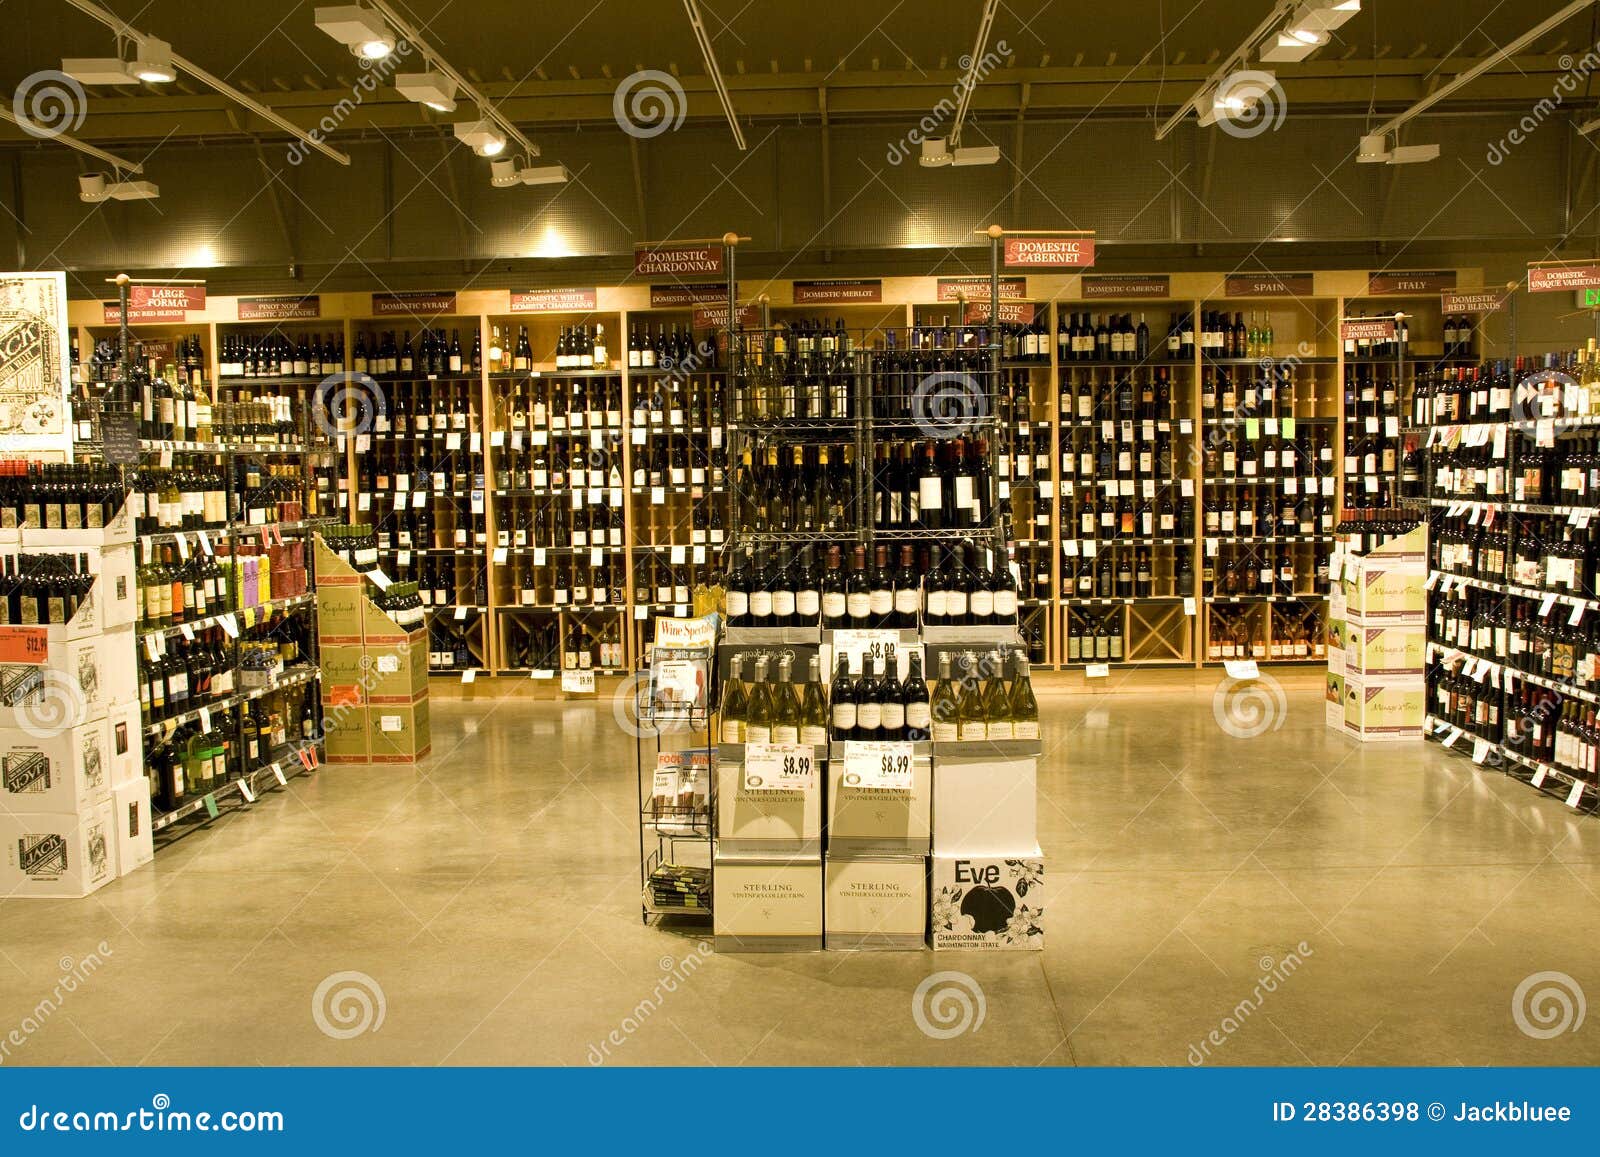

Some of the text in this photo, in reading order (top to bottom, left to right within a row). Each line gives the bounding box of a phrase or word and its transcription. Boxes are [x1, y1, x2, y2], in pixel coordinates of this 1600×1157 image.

[1018, 243, 1080, 252] DOMESTIC
[648, 251, 708, 262] DOMESTIC
[1017, 253, 1080, 262] CABERNET
[638, 261, 719, 273] CHARDONNAY
[1547, 271, 1586, 279] DOMESTIC
[1254, 283, 1284, 292] SPAIN
[1398, 281, 1426, 289] ITALY
[1531, 280, 1562, 289] UNIQUE
[152, 289, 185, 298] LARGE
[147, 299, 189, 307] FORMAT
[1452, 295, 1496, 304] DOMESTIC
[381, 301, 449, 310] DOMESTIC SYRAH
[979, 304, 1024, 313] DOESTIC
[1448, 302, 1500, 311] RED BLENDS
[157, 309, 183, 317] BLENDS
[703, 308, 748, 318] DOMETIC
[982, 312, 1019, 320] MRLOT
[1347, 330, 1388, 338] ZINFANDEL
[661, 620, 682, 635] Wine
[659, 755, 682, 764] FOOD
[881, 753, 909, 774] $8.99
[784, 754, 810, 776] $8.99
[955, 860, 1000, 884] Eve
